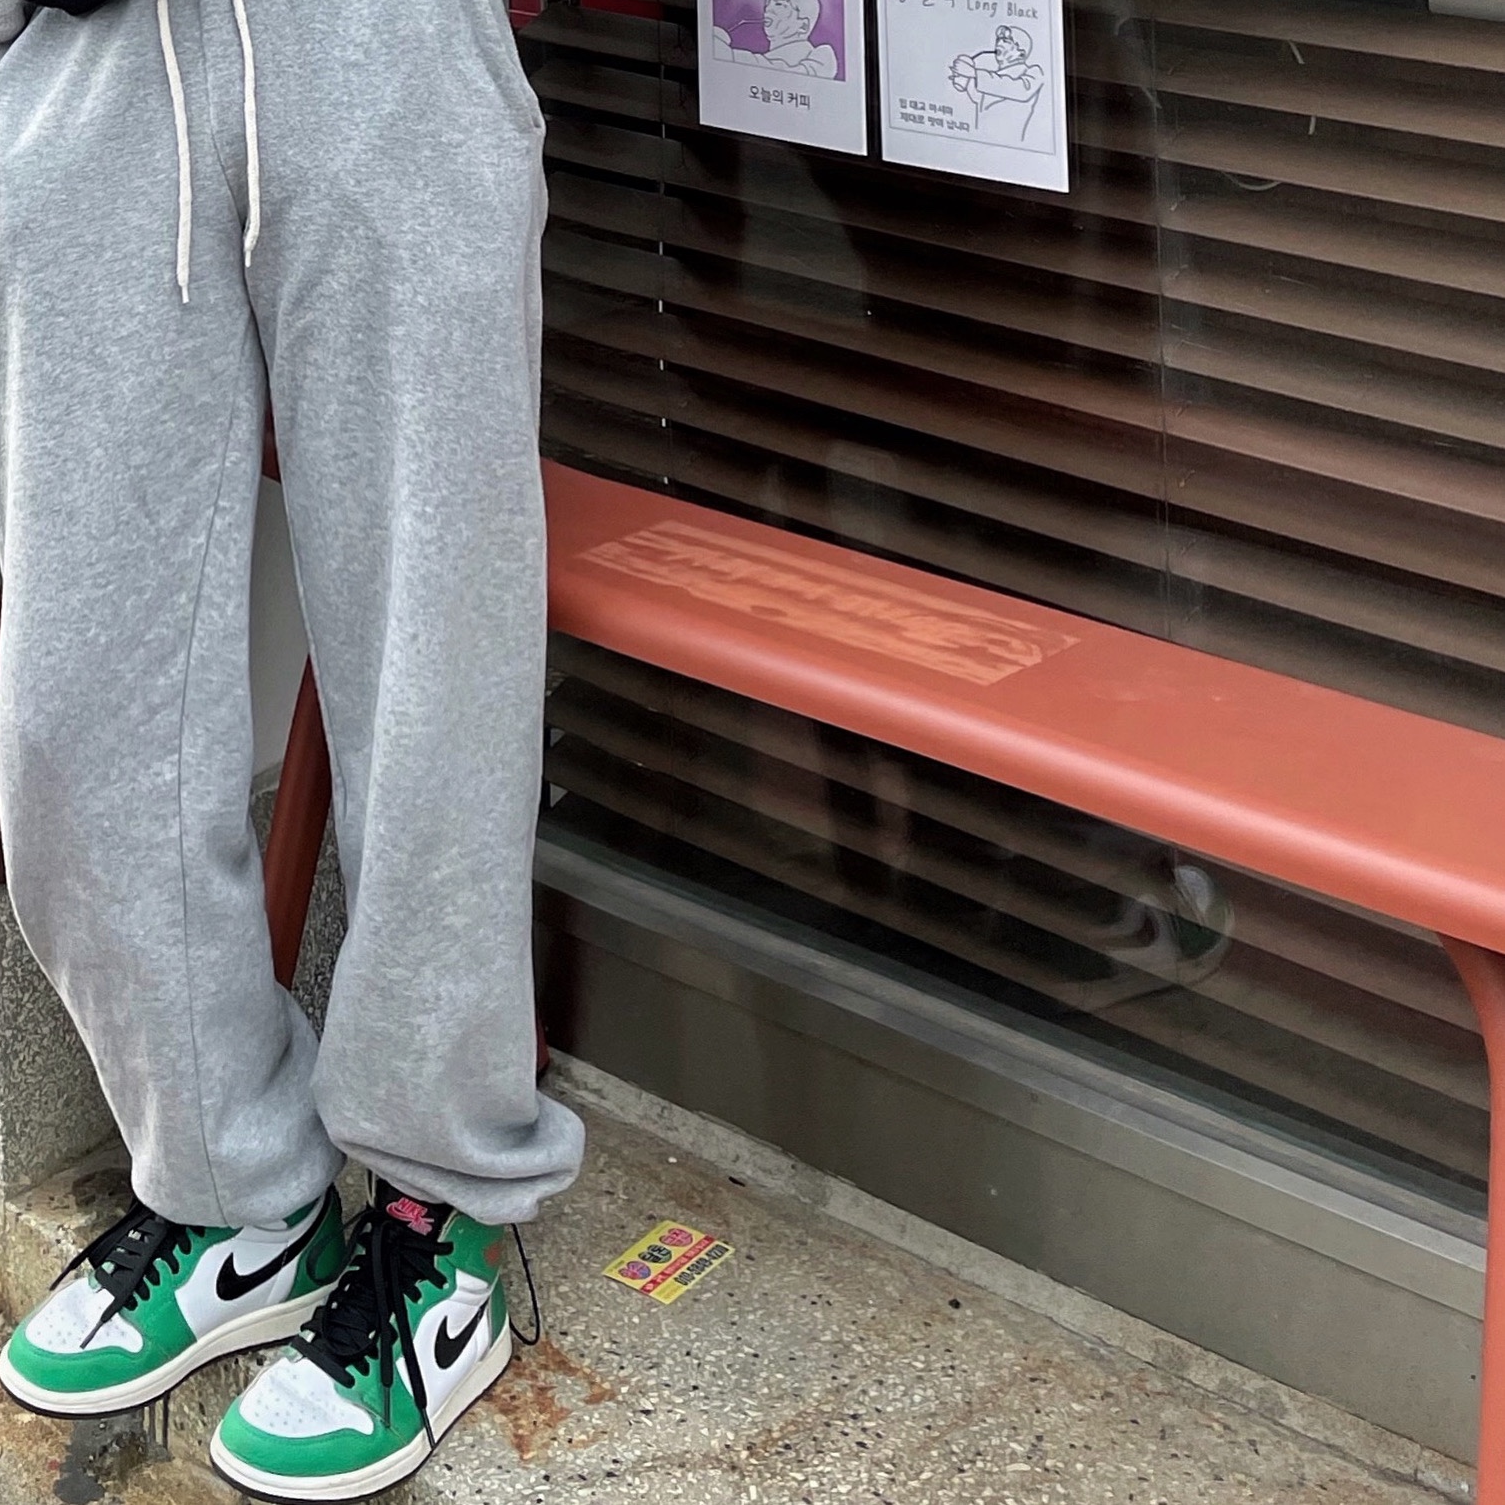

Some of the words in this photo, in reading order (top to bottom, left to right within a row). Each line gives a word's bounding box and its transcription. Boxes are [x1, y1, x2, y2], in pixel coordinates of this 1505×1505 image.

[1006, 1, 1039, 20] Black
[749, 85, 784, 105] 오늘의
[787, 92, 811, 111] 커피
